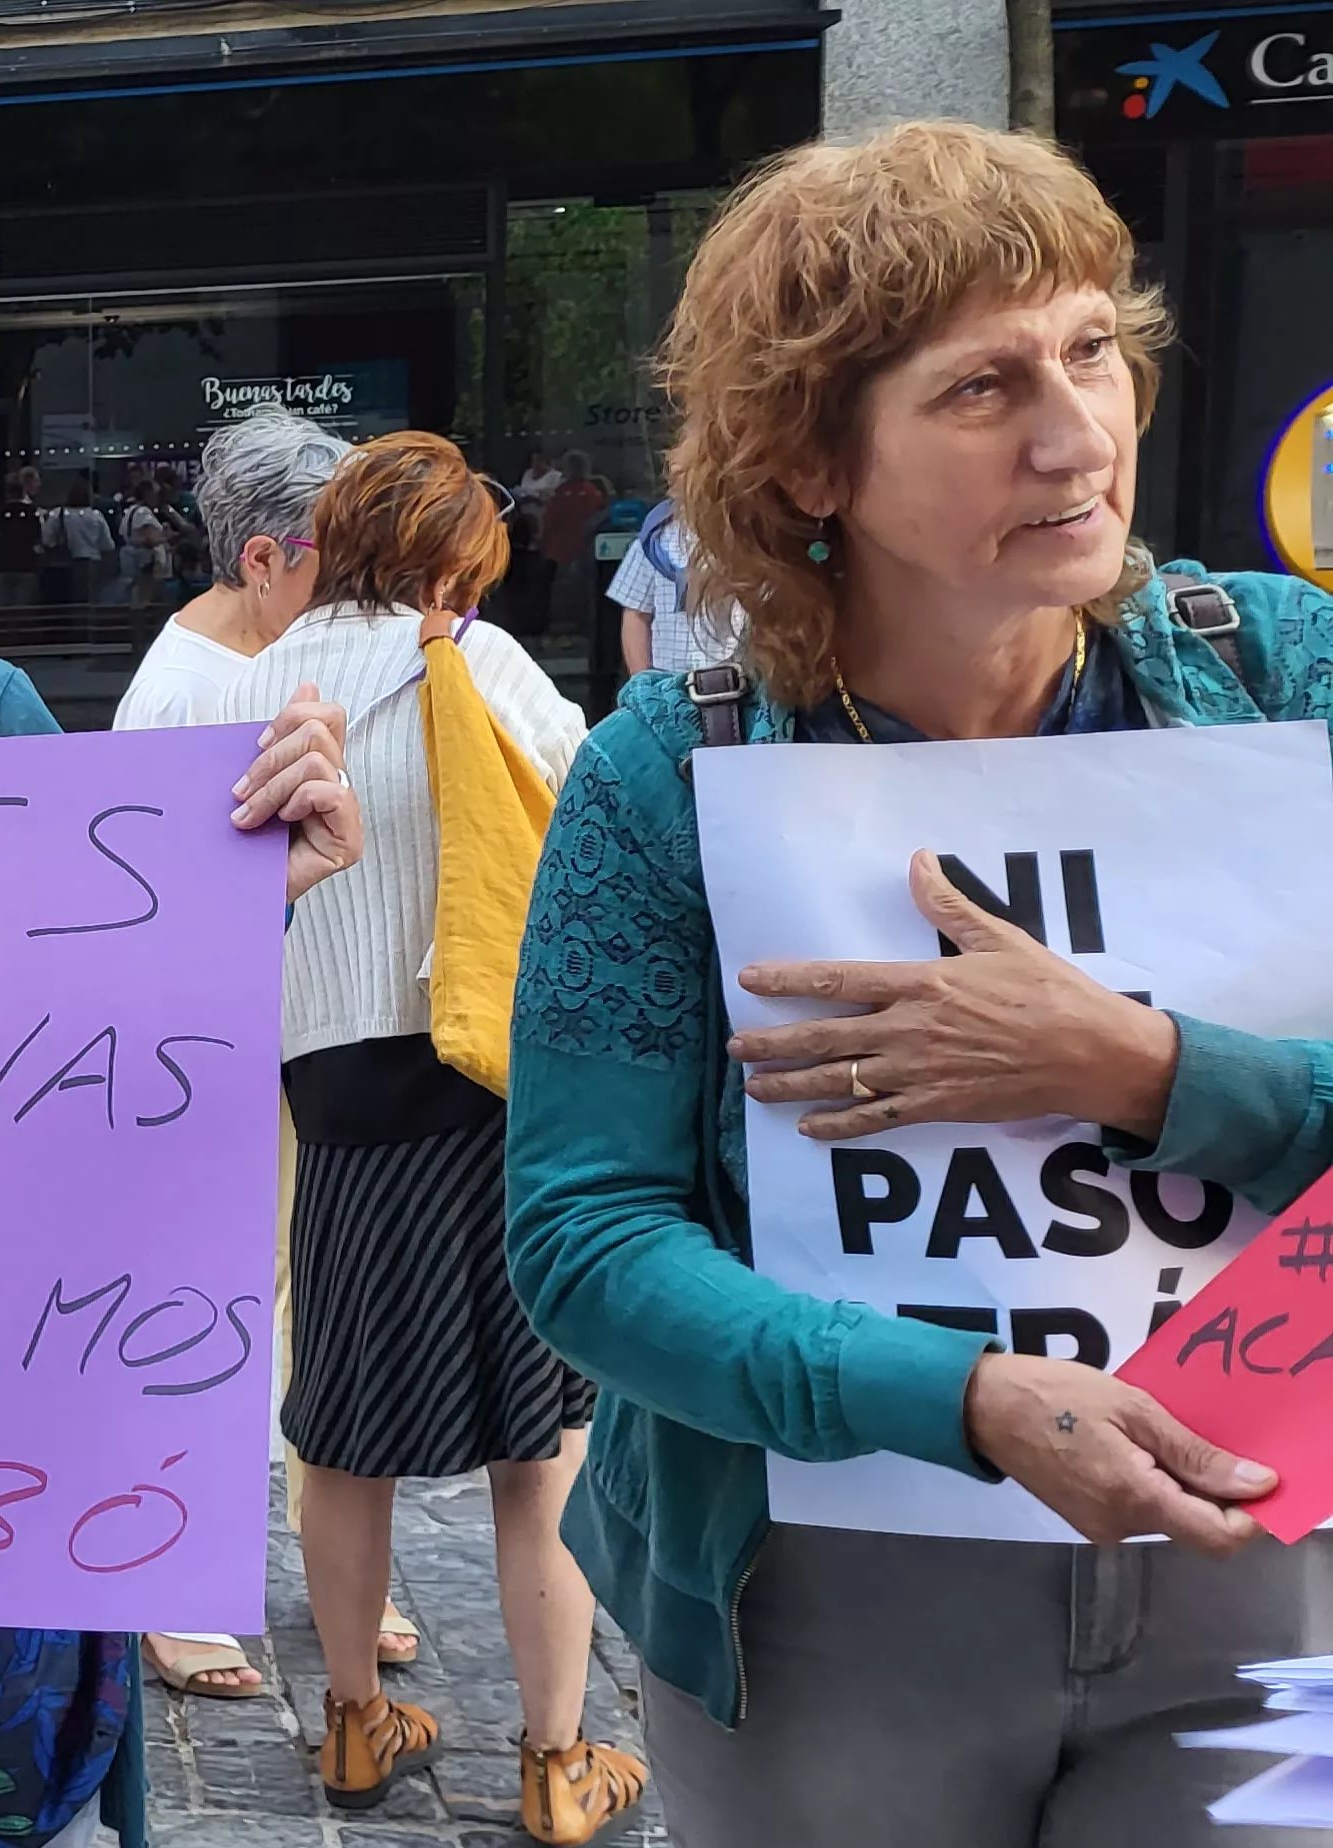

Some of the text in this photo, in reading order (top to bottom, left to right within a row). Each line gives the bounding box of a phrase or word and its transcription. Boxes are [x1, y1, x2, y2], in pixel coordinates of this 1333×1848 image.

[201, 377, 283, 409] Buenas
[584, 403, 662, 427] Store
[831, 1141, 1234, 1258] PASO
